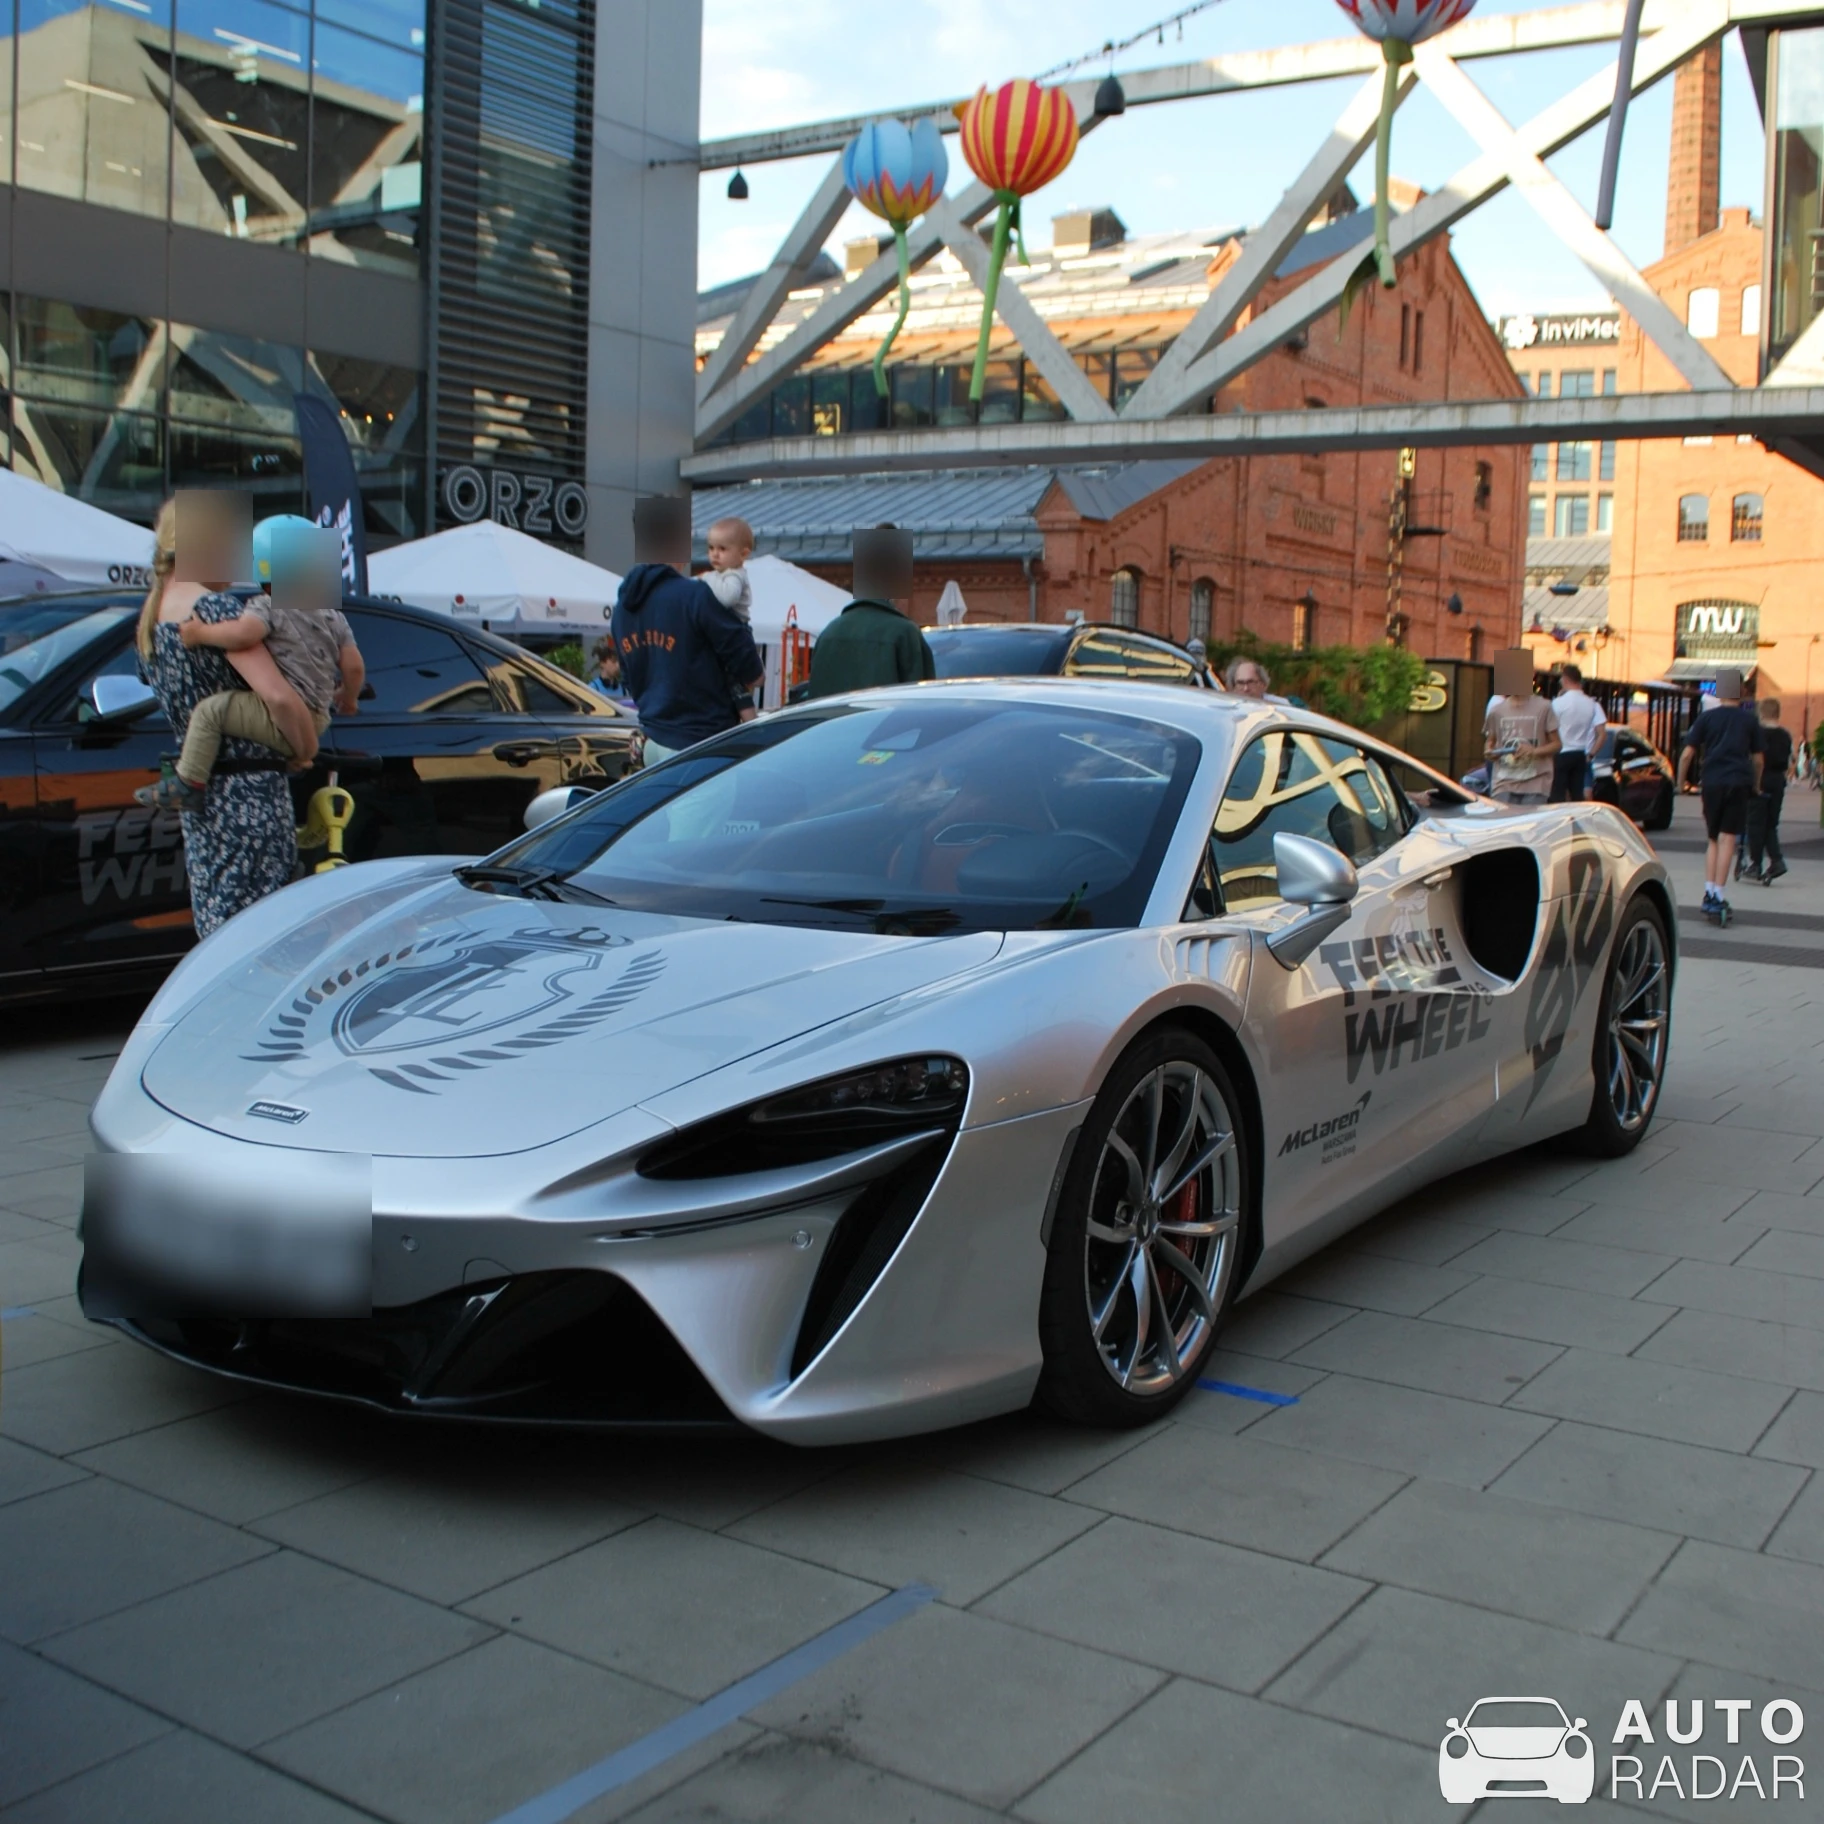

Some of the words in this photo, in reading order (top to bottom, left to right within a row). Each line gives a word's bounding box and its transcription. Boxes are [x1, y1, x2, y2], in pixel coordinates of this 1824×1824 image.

[446, 465, 590, 536] ORZO
[1345, 983, 1492, 1084] WHEEL
[1277, 1109, 1360, 1158] McLaren
